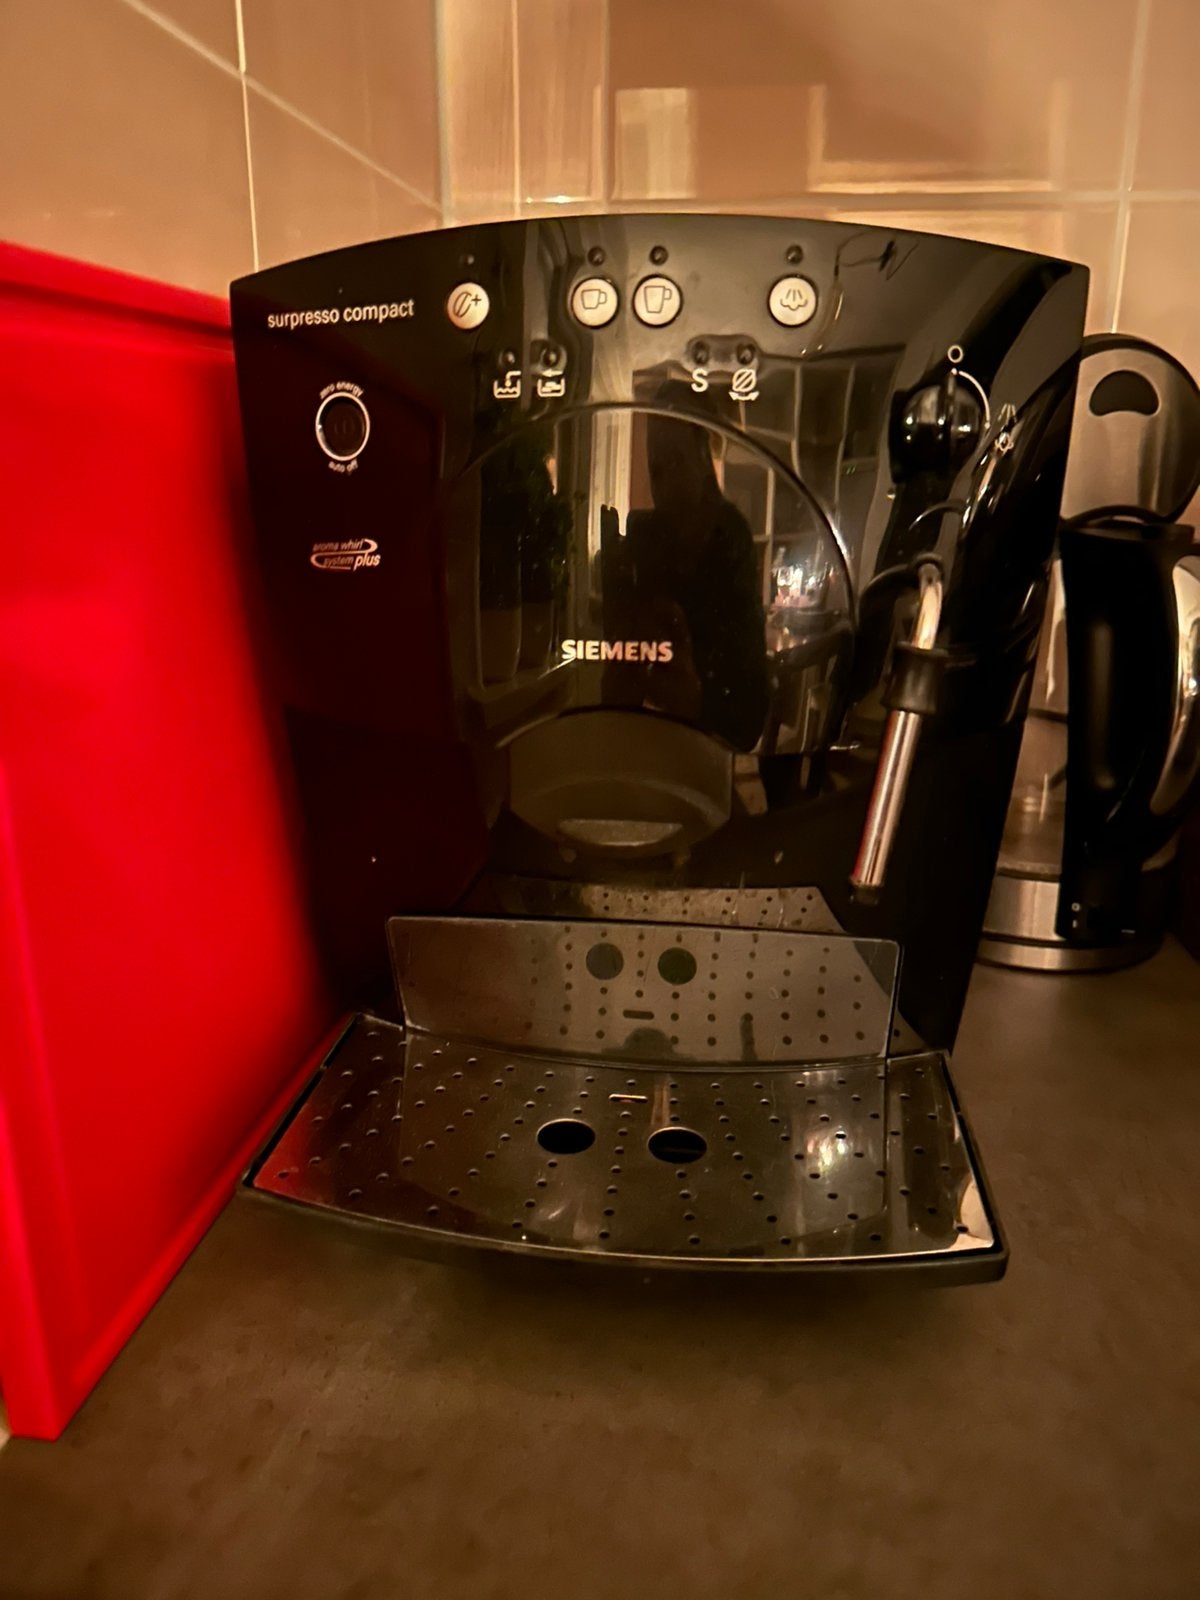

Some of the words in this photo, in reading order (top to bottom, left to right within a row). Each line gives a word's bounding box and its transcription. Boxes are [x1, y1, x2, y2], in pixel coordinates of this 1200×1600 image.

[267, 308, 340, 331] surpresso
[342, 298, 415, 324] compact
[335, 381, 364, 398] energy
[691, 368, 709, 393] S
[328, 460, 346, 473] auto
[346, 458, 359, 475] off
[313, 542, 340, 552] aroma
[340, 538, 364, 551] whirl
[323, 555, 355, 568] system
[353, 551, 381, 572] plus
[561, 639, 674, 663] SIEMENS
